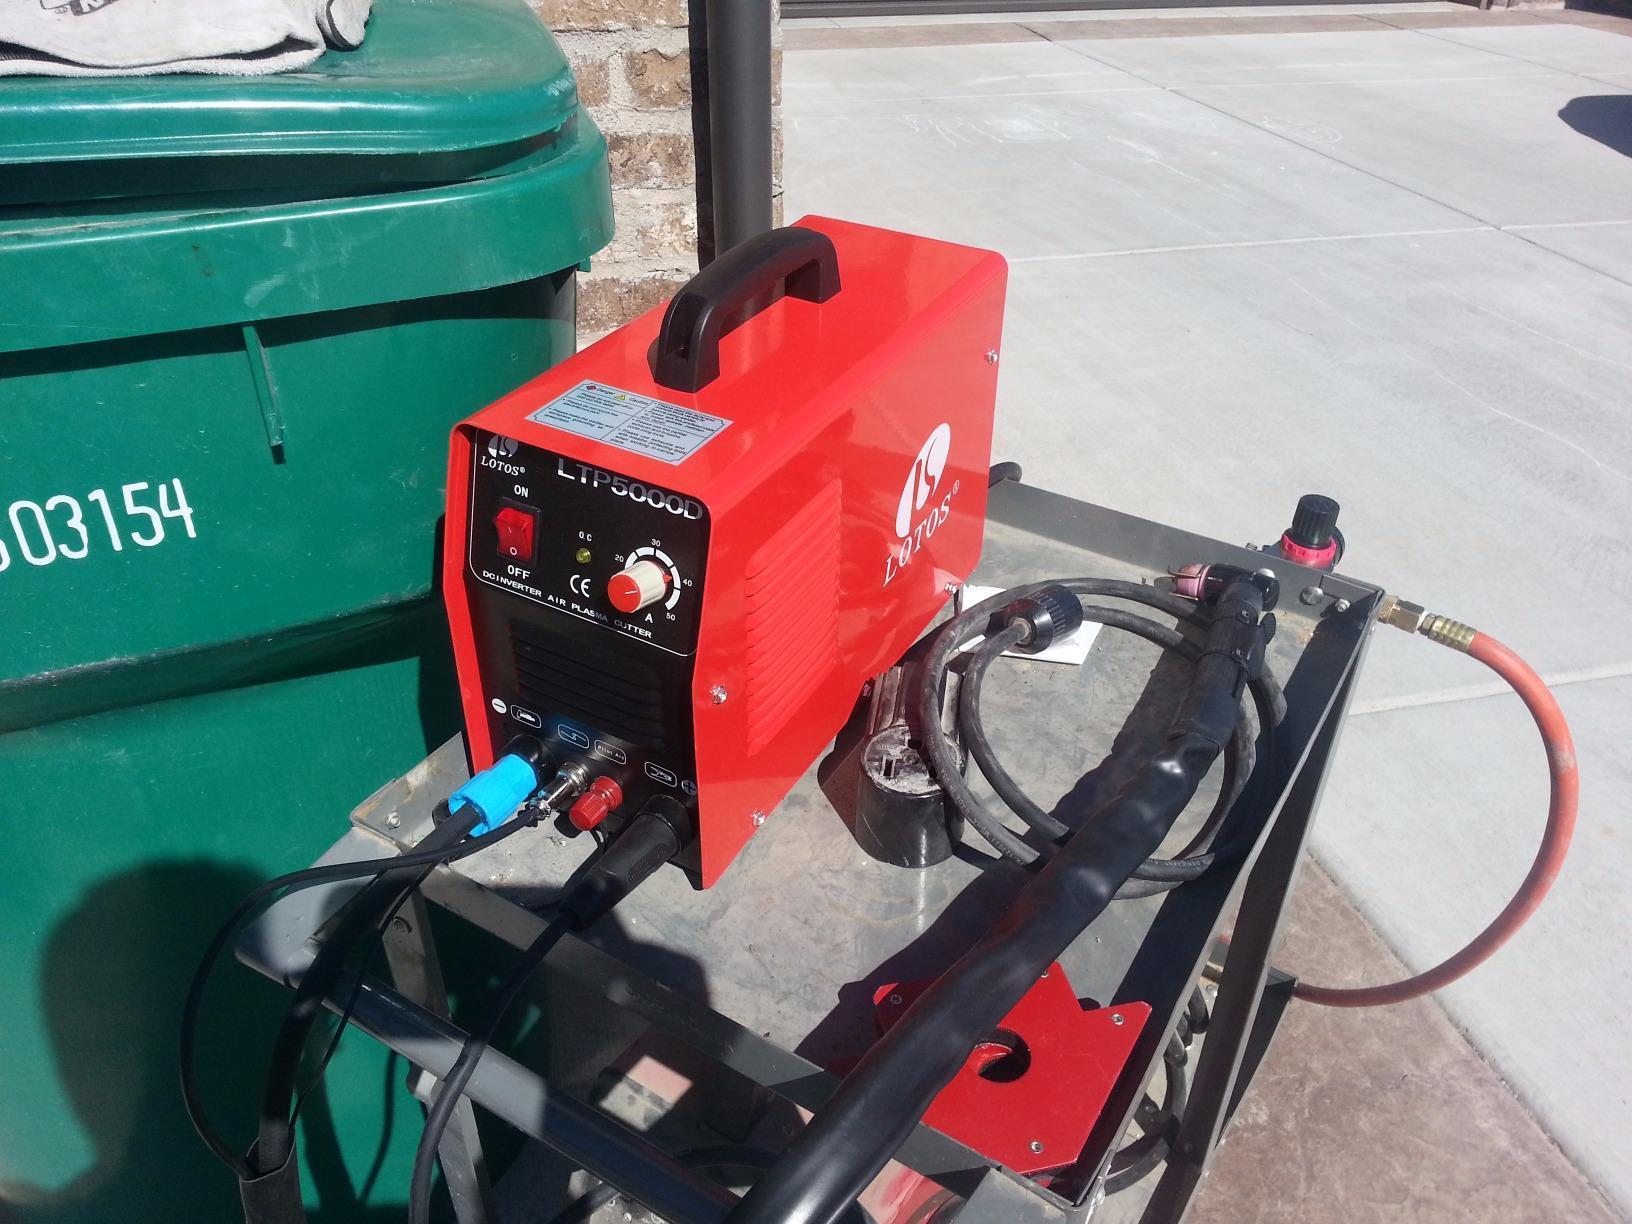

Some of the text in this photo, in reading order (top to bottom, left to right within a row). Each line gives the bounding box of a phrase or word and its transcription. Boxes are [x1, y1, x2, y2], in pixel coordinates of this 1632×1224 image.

[514, 484, 529, 498] ON
[557, 457, 703, 520] LTP5000D
[0, 478, 197, 572] 03154
[651, 538, 661, 547] 30
[614, 554, 624, 562] 20
[507, 564, 531, 579] OFF
[682, 578, 693, 587] 40
[547, 595, 566, 607] AIR
[571, 603, 608, 622] PLASMA
[614, 619, 652, 639] CUTTER
[644, 613, 653, 624] A
[665, 612, 676, 621] 50
